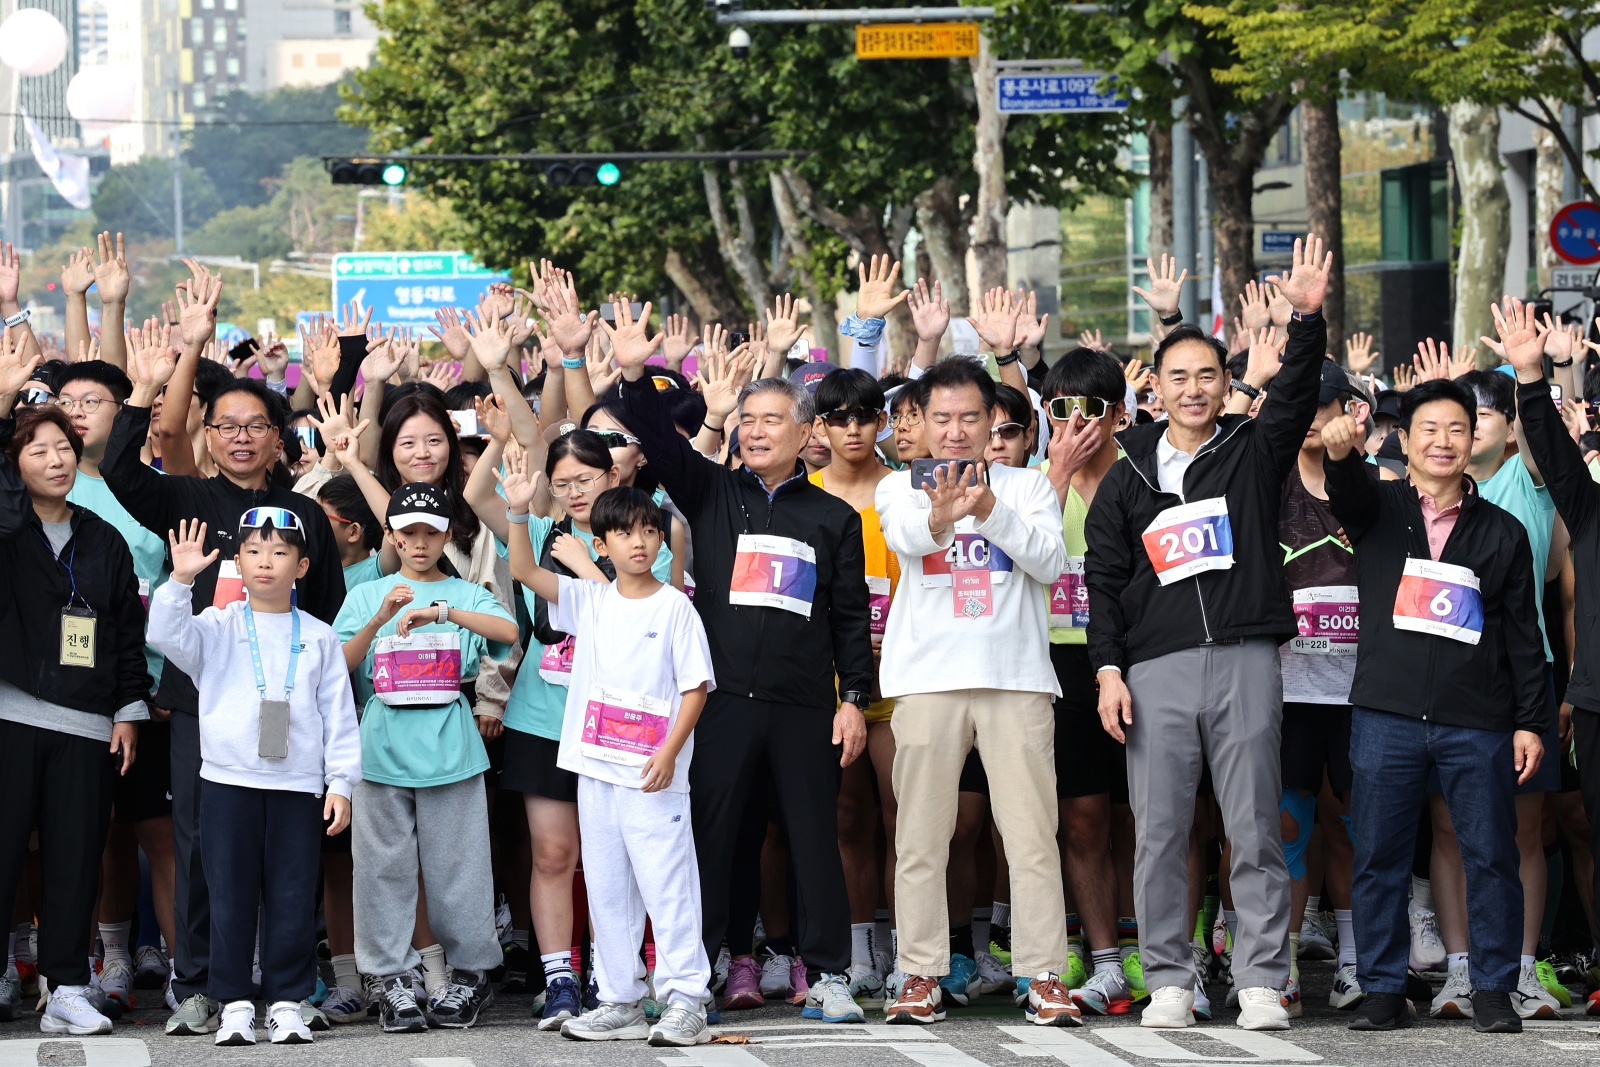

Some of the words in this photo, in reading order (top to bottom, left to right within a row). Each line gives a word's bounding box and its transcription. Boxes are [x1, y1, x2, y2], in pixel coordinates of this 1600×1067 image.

[1558, 228, 1600, 239] 주차금
[394, 286, 457, 305] 영동대로
[401, 493, 418, 507] NEW
[420, 493, 439, 509] YORK
[1159, 523, 1219, 563] 201
[945, 540, 990, 567] 40
[770, 560, 783, 588] 1
[1053, 587, 1067, 601] A
[1430, 588, 1453, 616] 6
[1297, 615, 1310, 629] A
[66, 633, 90, 648] 진행
[1295, 640, 1328, 649] 아-228
[546, 644, 559, 659] A
[376, 665, 390, 680] A
[399, 662, 455, 678] 50472
[585, 714, 597, 731] A
